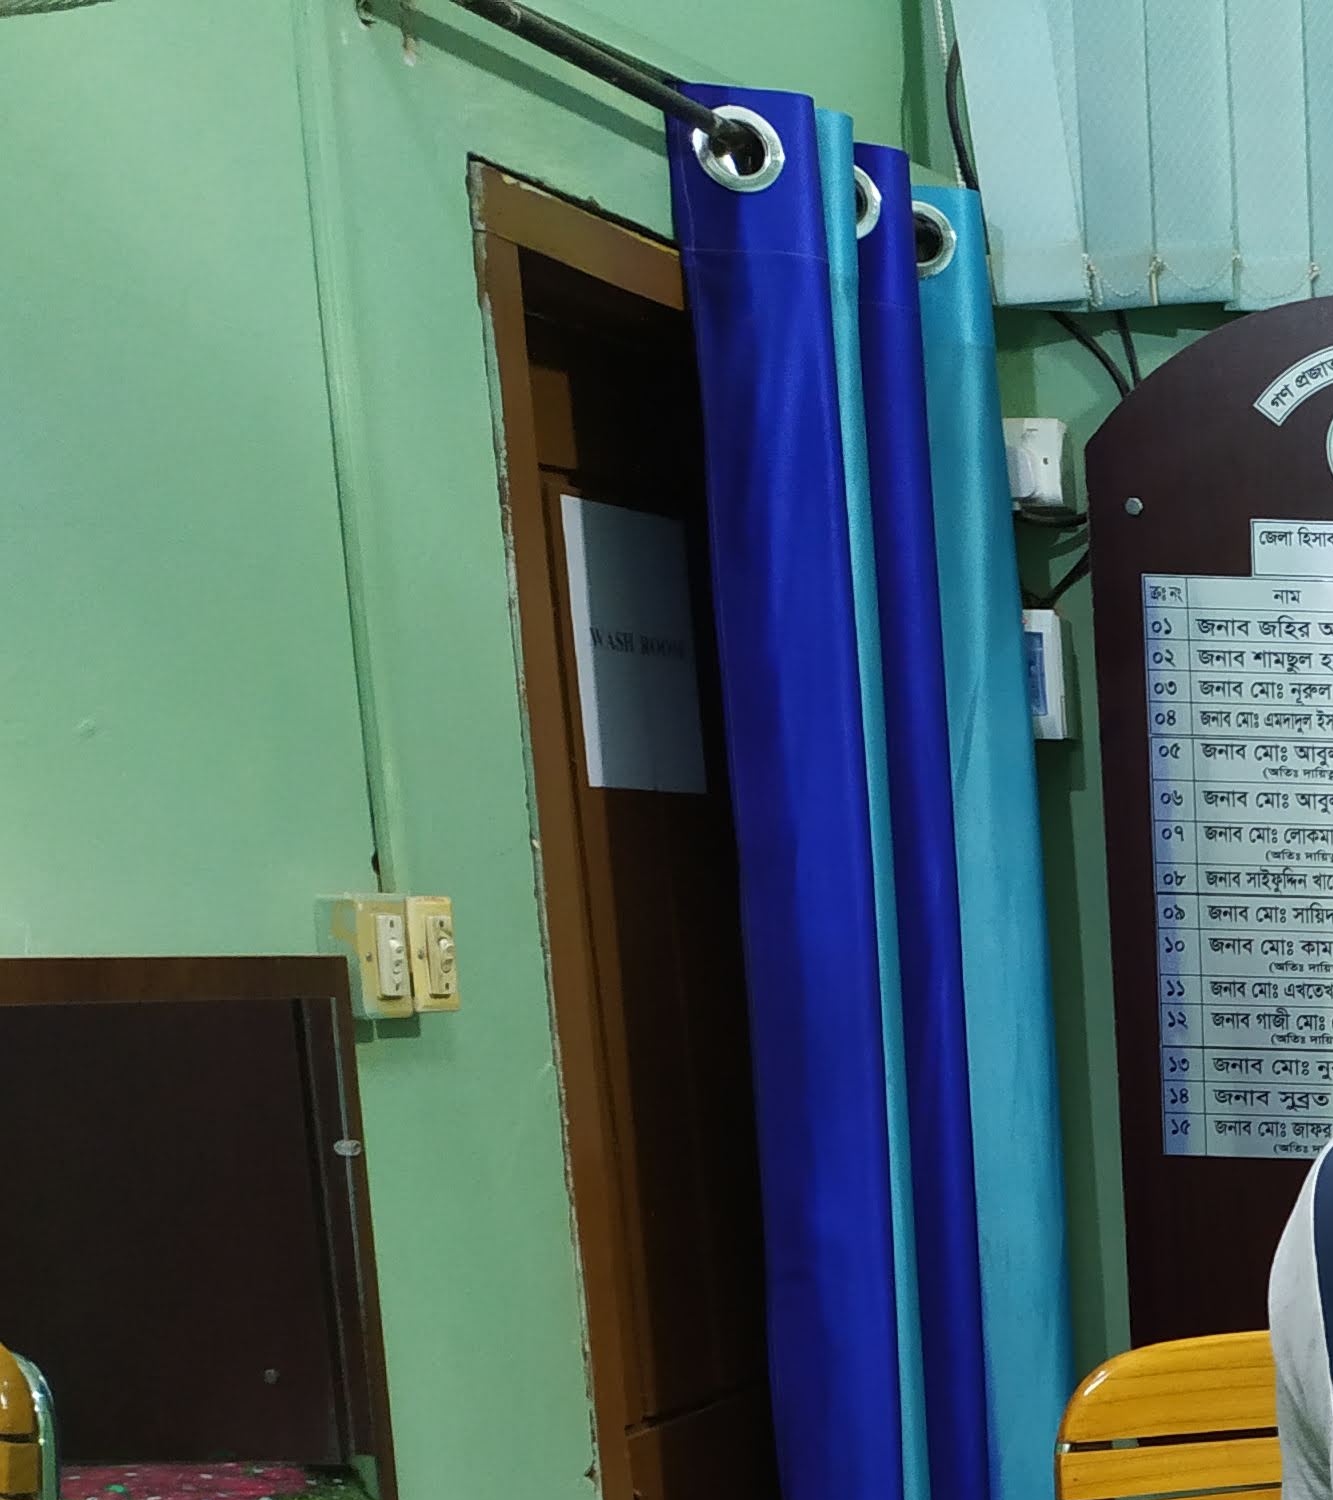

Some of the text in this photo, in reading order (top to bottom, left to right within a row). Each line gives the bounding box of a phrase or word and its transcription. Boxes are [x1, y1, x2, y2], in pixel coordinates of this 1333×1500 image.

[1270, 383, 1295, 409] গণ
[1258, 529, 1292, 546] জেলা
[1272, 589, 1302, 605] নাম
[1151, 618, 1173, 635] ০১
[1197, 618, 1251, 637] জনাব
[1258, 614, 1311, 639] জহির
[589, 625, 634, 654] WASH
[1152, 650, 1176, 668] ০২
[1197, 649, 1247, 668] জনাব
[1253, 651, 1313, 674] শামছুল
[1153, 683, 1178, 697] ০৩
[1198, 679, 1244, 699] জনাব
[1250, 682, 1285, 700] মোঃ
[1154, 710, 1176, 727] ০৪
[1199, 710, 1232, 728] জনাব
[1236, 712, 1260, 729] মোঃ
[1158, 744, 1181, 759] ০৫
[1200, 743, 1247, 761] জনাব
[1254, 744, 1288, 763] মোঃ
[1160, 790, 1184, 806] ০৬
[1202, 789, 1248, 808] জনাব
[1255, 791, 1290, 810] মোঃ
[1161, 825, 1185, 843] ০৭
[1203, 825, 1243, 844] জনাব
[1248, 826, 1278, 844] মোঃ
[1162, 872, 1187, 888] ০৮
[1205, 870, 1242, 887] জনাব
[1163, 906, 1186, 921] ০৯
[1207, 905, 1249, 923] জনাব
[1255, 906, 1287, 924] মোঃ
[1164, 935, 1186, 953] ১০
[1208, 937, 1253, 957] জনাব
[1261, 939, 1294, 957] মোঃ
[1165, 980, 1186, 998] ১১
[1209, 980, 1247, 999] জনাব
[1251, 982, 1280, 1000] মোঃ
[1166, 1010, 1188, 1029] ১২
[1210, 1011, 1251, 1030] জনাব
[1256, 1007, 1292, 1031] গাজী
[1296, 1015, 1326, 1032] মোঃ
[1168, 1056, 1190, 1073] ১৩
[1212, 1057, 1265, 1076] জনাব
[1271, 1060, 1311, 1077] মোঃ
[1169, 1087, 1190, 1105] ১৪
[1212, 1088, 1271, 1107] জনাব
[1278, 1090, 1331, 1113] সুব্রত
[1171, 1118, 1192, 1136] ১৫
[1213, 1119, 1253, 1137] জনাব
[1257, 1121, 1287, 1138] মোঃ
